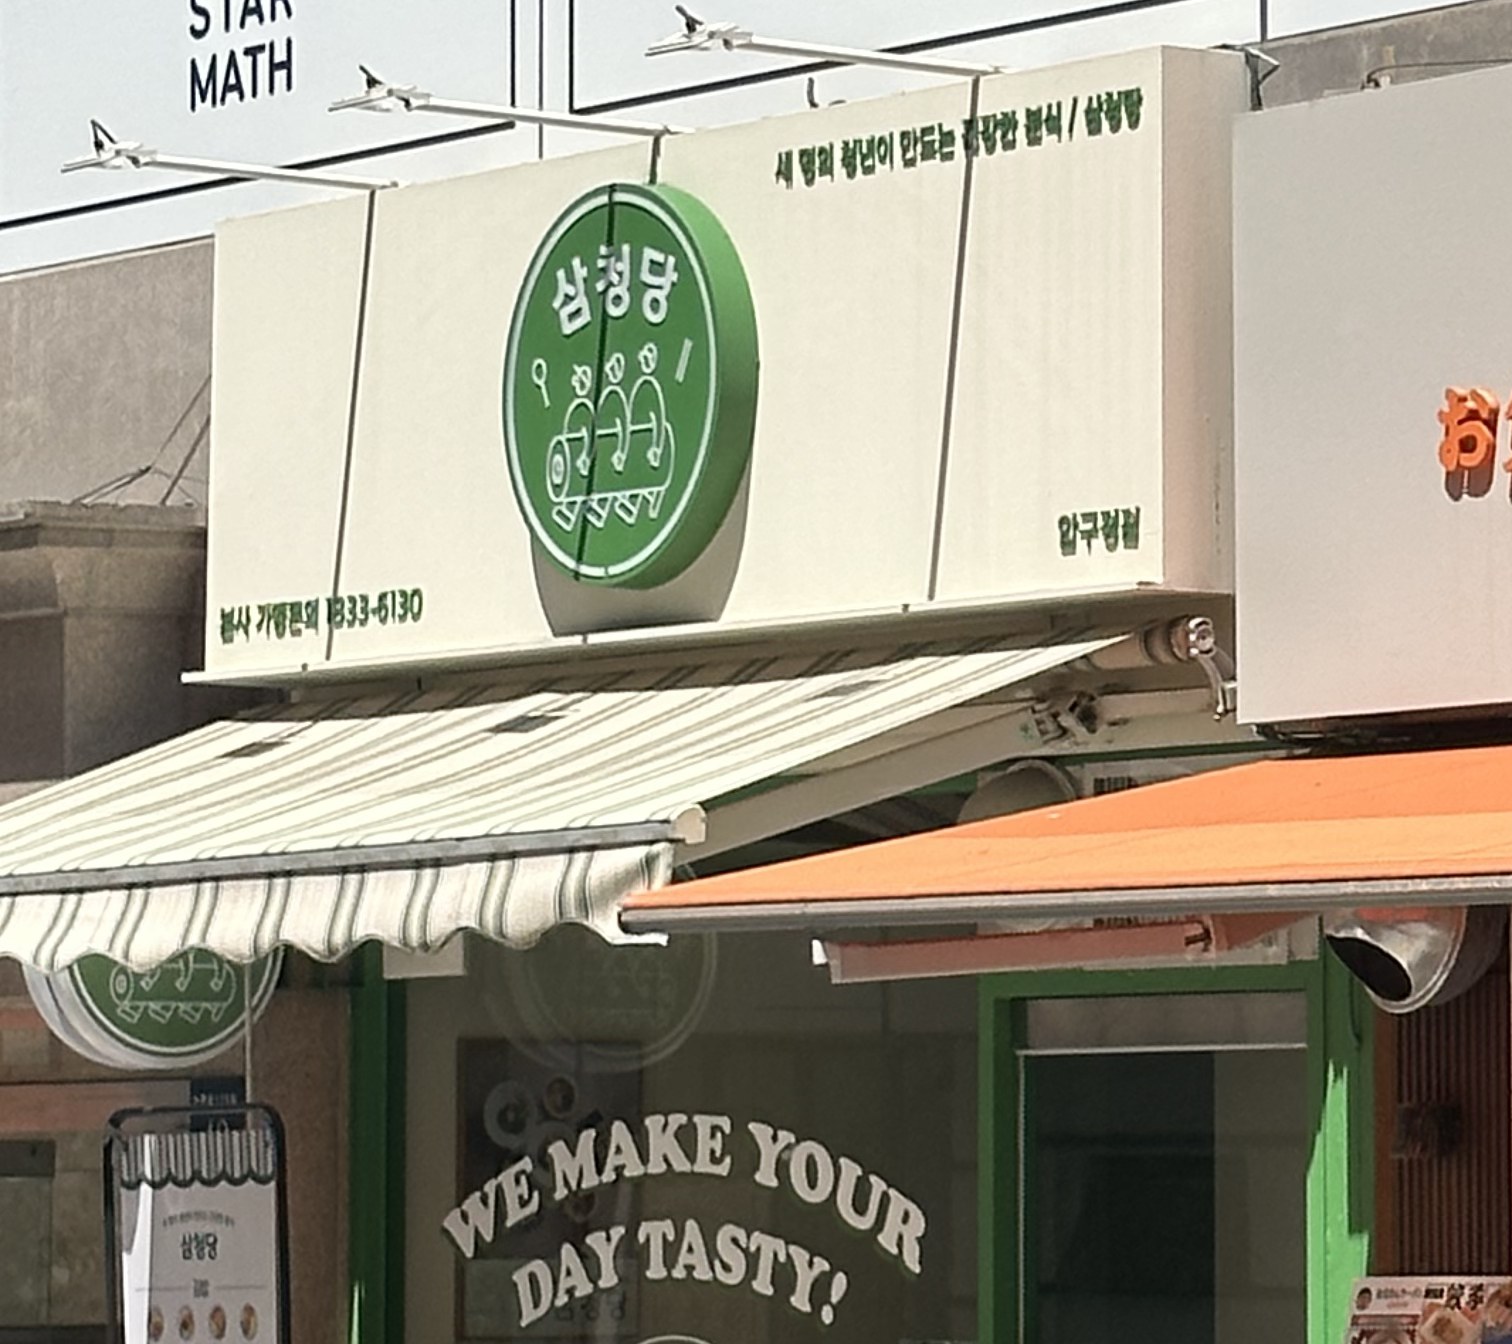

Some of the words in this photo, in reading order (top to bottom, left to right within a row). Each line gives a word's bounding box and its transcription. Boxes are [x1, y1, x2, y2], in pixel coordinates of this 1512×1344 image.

[190, 37, 293, 113] MATH
[775, 150, 794, 189] 세
[901, 123, 956, 168] 만드는
[552, 242, 679, 338] 삼청당
[442, 1156, 540, 1258] WE
[547, 1112, 732, 1201] MAKE
[747, 1121, 926, 1274] YOUR
[511, 1225, 626, 1328] DAY
[637, 1218, 849, 1326] TASTY!
